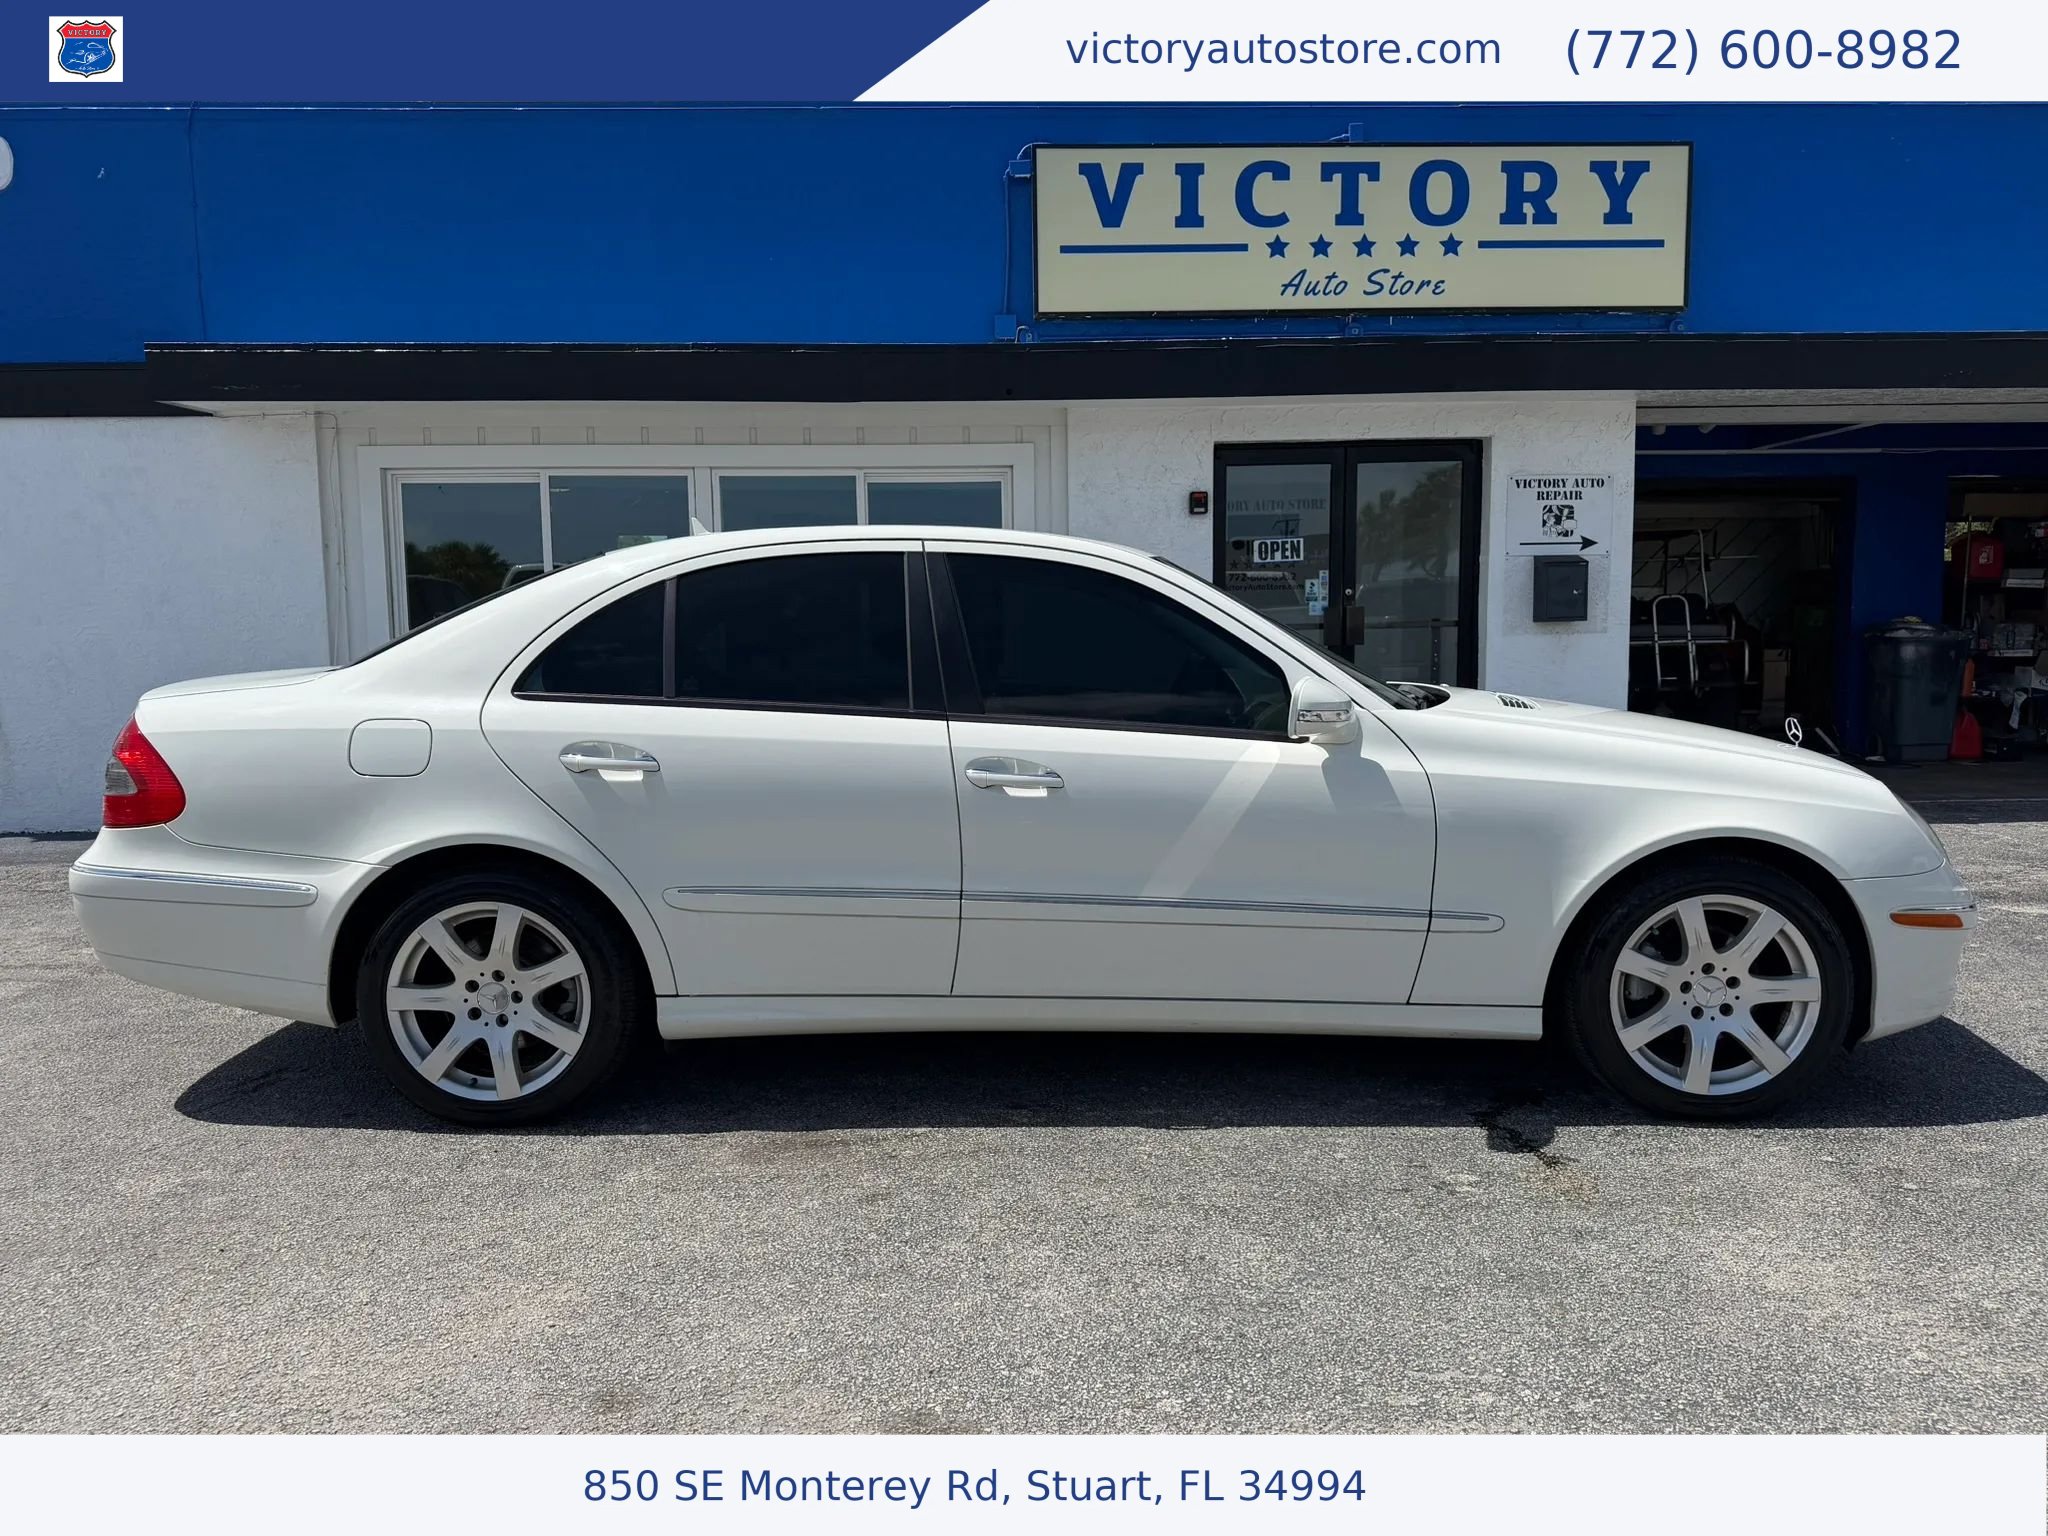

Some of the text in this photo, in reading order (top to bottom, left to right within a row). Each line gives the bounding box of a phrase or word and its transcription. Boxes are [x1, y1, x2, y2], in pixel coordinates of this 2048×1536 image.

[1078, 159, 1650, 228] VICTORY
[1280, 268, 1446, 297] Auto Store
[1515, 478, 1605, 489] VICTORY AUTO
[1537, 490, 1583, 501] REPAIR
[1288, 498, 1327, 511] STORE
[1258, 540, 1301, 561] OPEN
